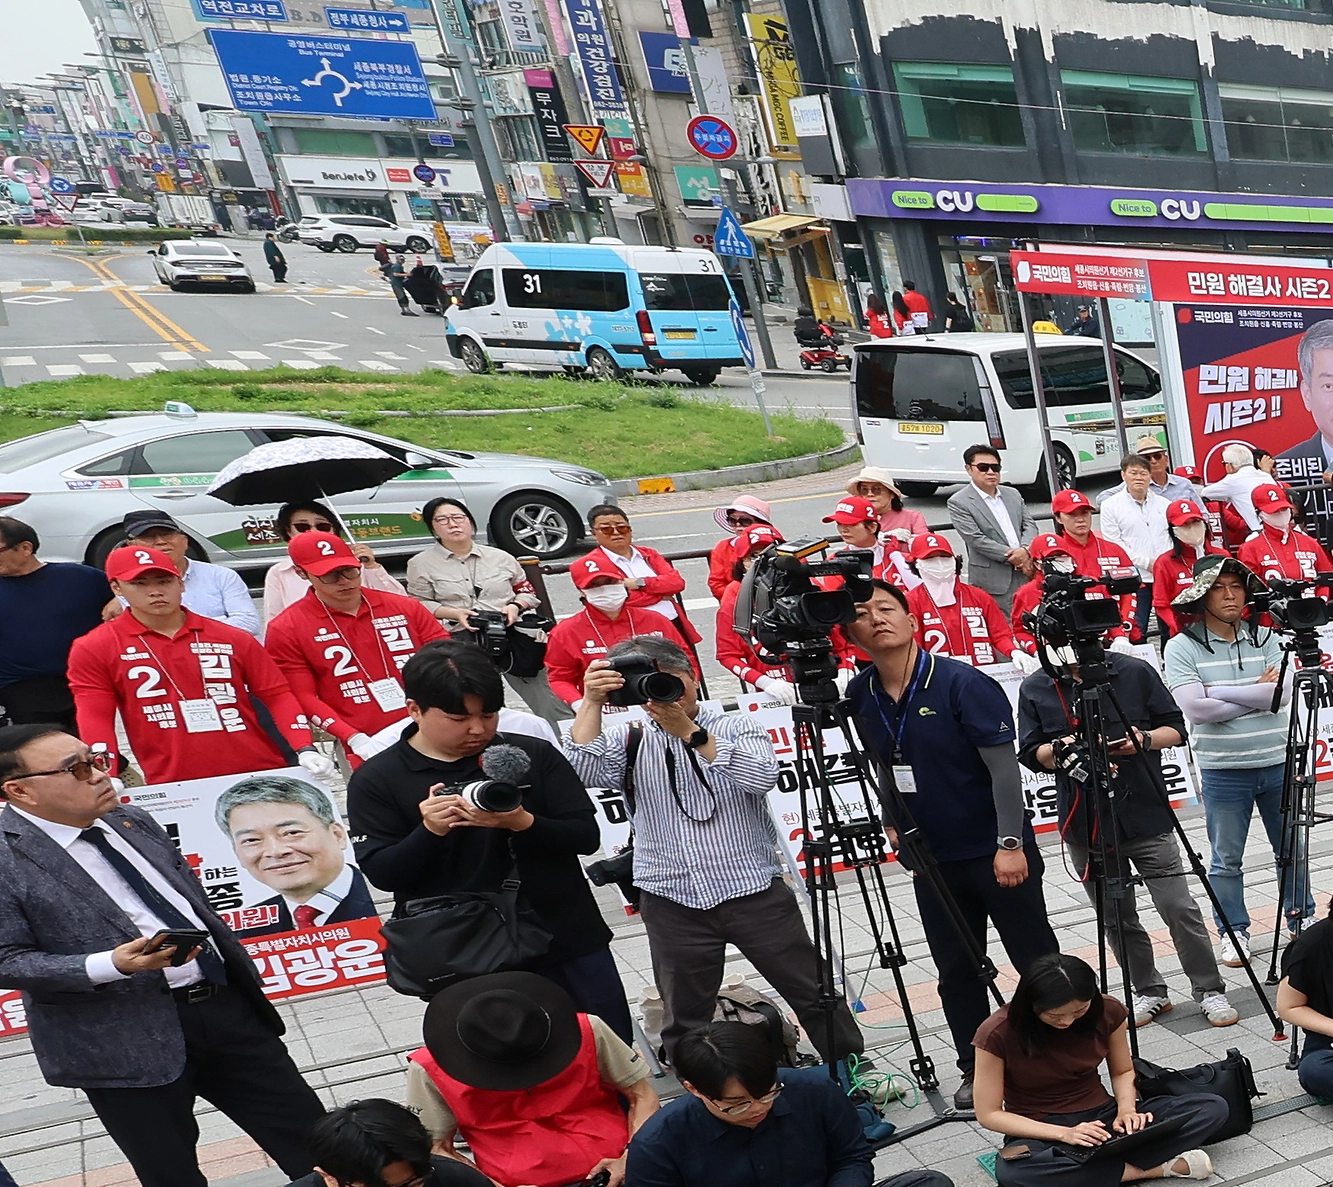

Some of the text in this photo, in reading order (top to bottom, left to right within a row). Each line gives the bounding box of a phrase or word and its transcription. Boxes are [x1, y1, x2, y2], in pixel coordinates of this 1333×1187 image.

[330, 12, 387, 27] 정부세종청사
[535, 92, 562, 138] 무자크
[898, 190, 974, 213] Nice to CU
[1118, 198, 1200, 221] Nice to CU
[699, 259, 717, 272] 31
[1032, 264, 1072, 284] 국민의힘
[1133, 268, 1145, 278] 후보
[523, 274, 542, 294] 31
[1187, 272, 1224, 295] 민원
[1228, 276, 1281, 298] 해결사
[1286, 279, 1332, 299] 시즌2
[1194, 310, 1234, 325] 국민의힘
[1199, 364, 1298, 394] 민원 해결사
[1203, 399, 1266, 435] 시즌2
[1071, 493, 1081, 503] 2
[1268, 491, 1278, 500] 2
[1180, 503, 1191, 513] 2
[316, 540, 335, 556] 2
[926, 536, 938, 547] 2
[1047, 537, 1057, 547] 2
[134, 551, 153, 565] 2
[586, 560, 599, 573] 2
[924, 630, 949, 657] 2
[324, 645, 359, 677] 2
[127, 666, 167, 699] 2
[199, 654, 246, 733] 김광운
[205, 866, 238, 880] 하는
[258, 939, 386, 994] 김광운
